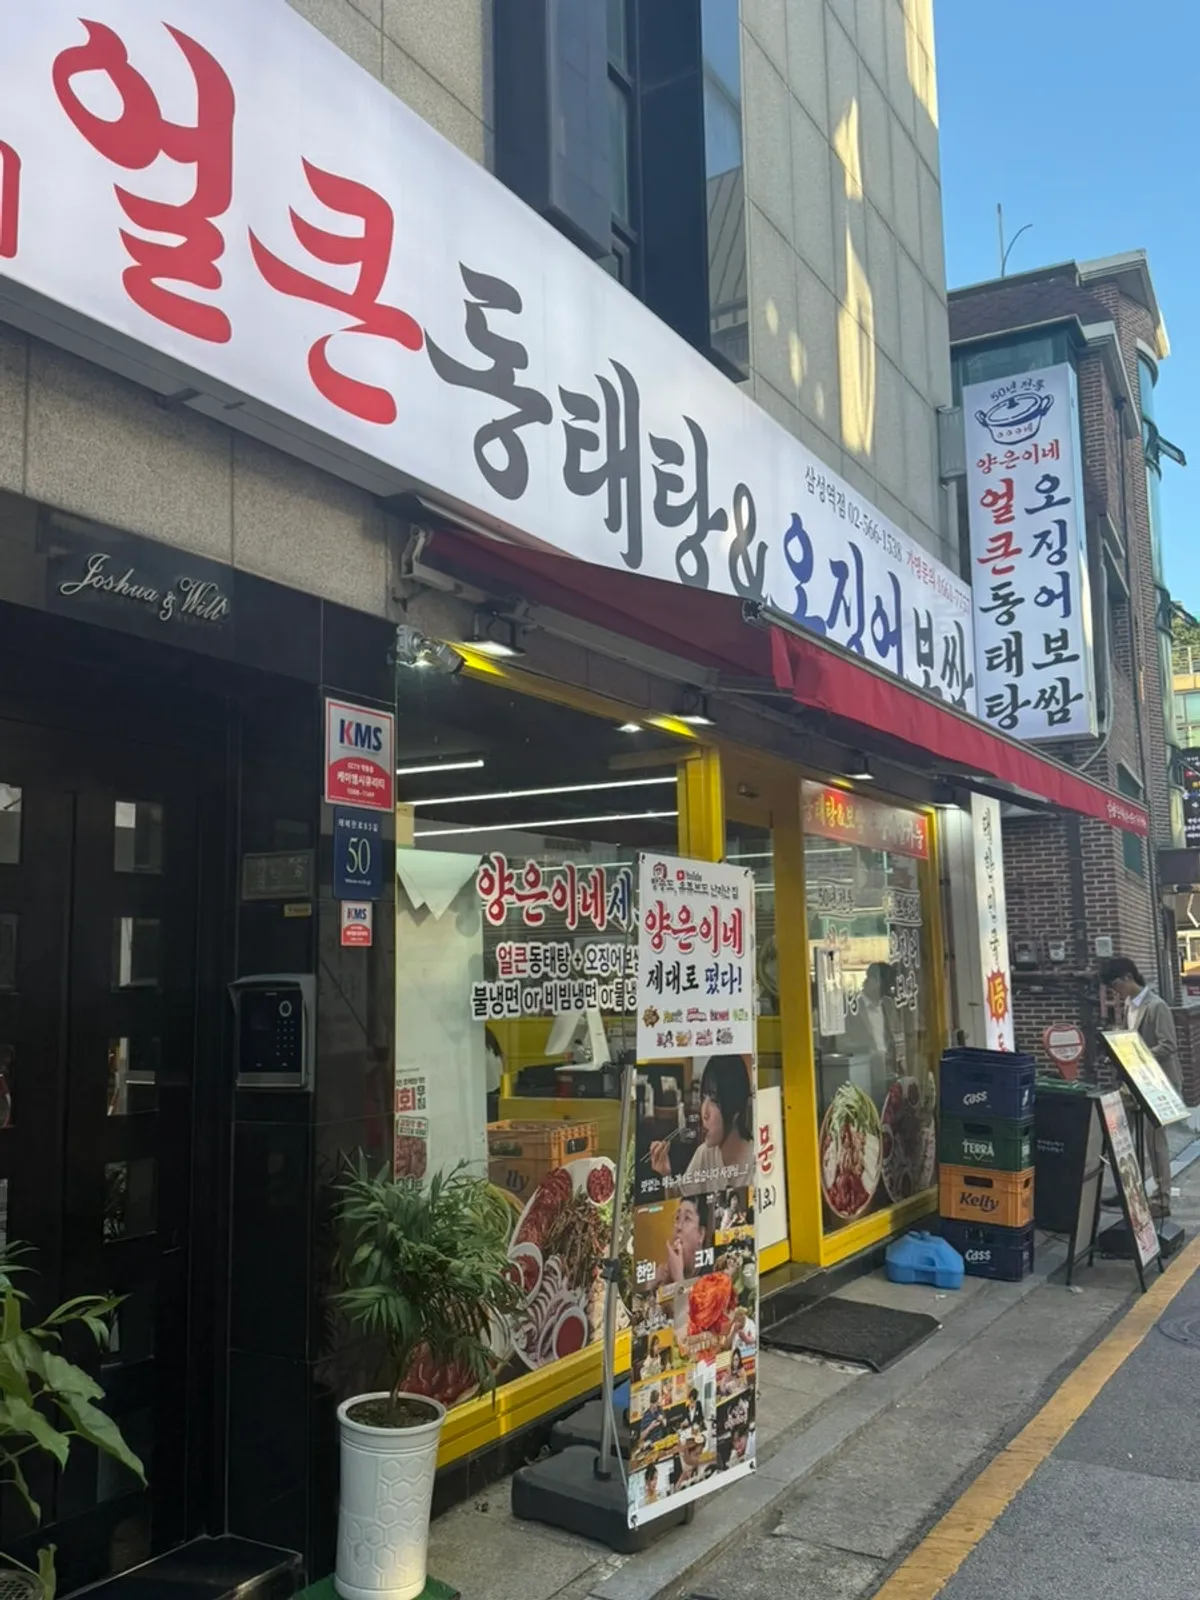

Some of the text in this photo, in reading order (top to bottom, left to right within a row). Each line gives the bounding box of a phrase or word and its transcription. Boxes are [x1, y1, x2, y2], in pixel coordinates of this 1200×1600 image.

[976, 438, 1060, 475] 양은이네
[805, 465, 846, 520] 삼성역점
[60, 553, 159, 603] Joshua
[339, 718, 382, 751] KMS
[346, 836, 371, 875] 50
[645, 901, 744, 955] 양은이네
[646, 960, 743, 996] 제대로 떴다!
[472, 983, 520, 1018] 불냉면
[524, 994, 540, 1010] or
[545, 981, 598, 1011] 비빔냉면
[962, 1090, 988, 1106] Cass
[962, 1139, 995, 1157] TERRA
[960, 1191, 999, 1212] Kelly
[636, 1248, 714, 1284] 한입 크게
[965, 1249, 992, 1263] Cass
